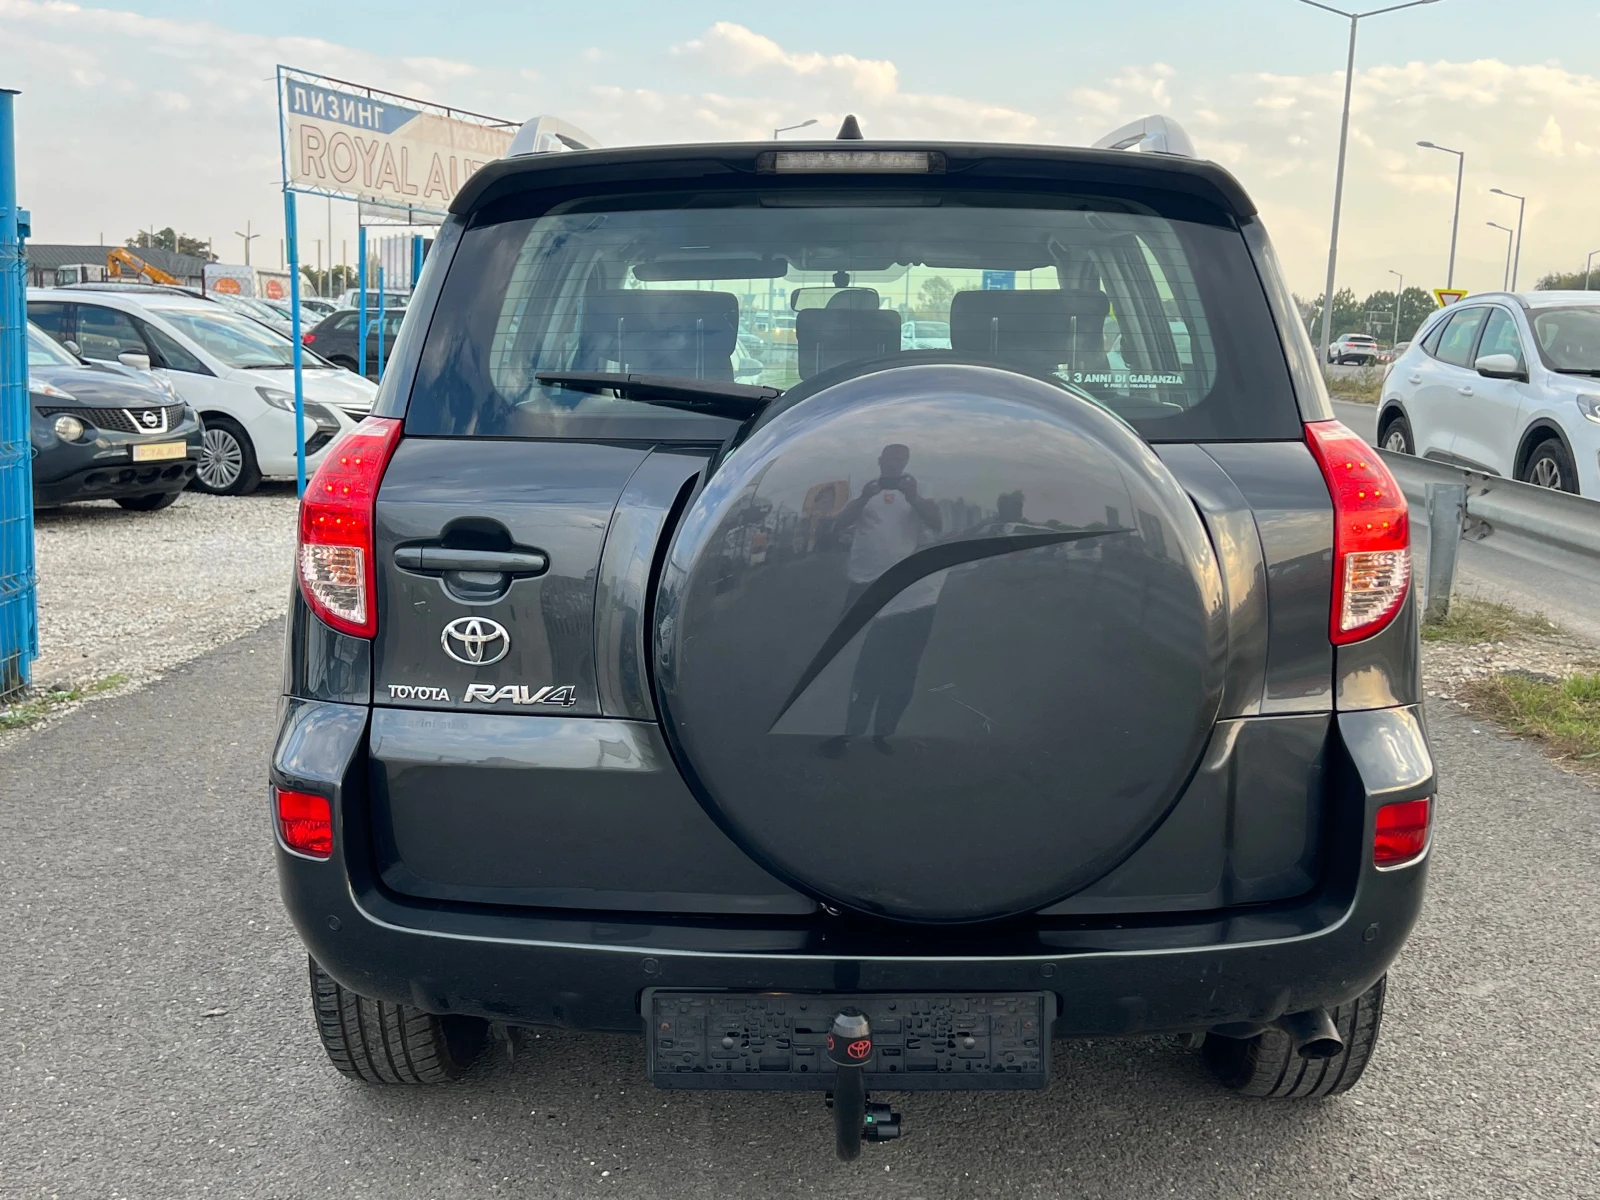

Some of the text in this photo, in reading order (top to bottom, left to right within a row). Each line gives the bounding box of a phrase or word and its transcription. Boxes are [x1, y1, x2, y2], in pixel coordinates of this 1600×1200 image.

[294, 87, 384, 129] ЛИЗИНГ
[300, 124, 487, 201] ROYAL AU
[1073, 372, 1183, 385] 3 ANNI DI GARANZIA
[140, 445, 186, 458] ROYAL AUTO
[388, 683, 577, 708] TOYOTA RAV4
